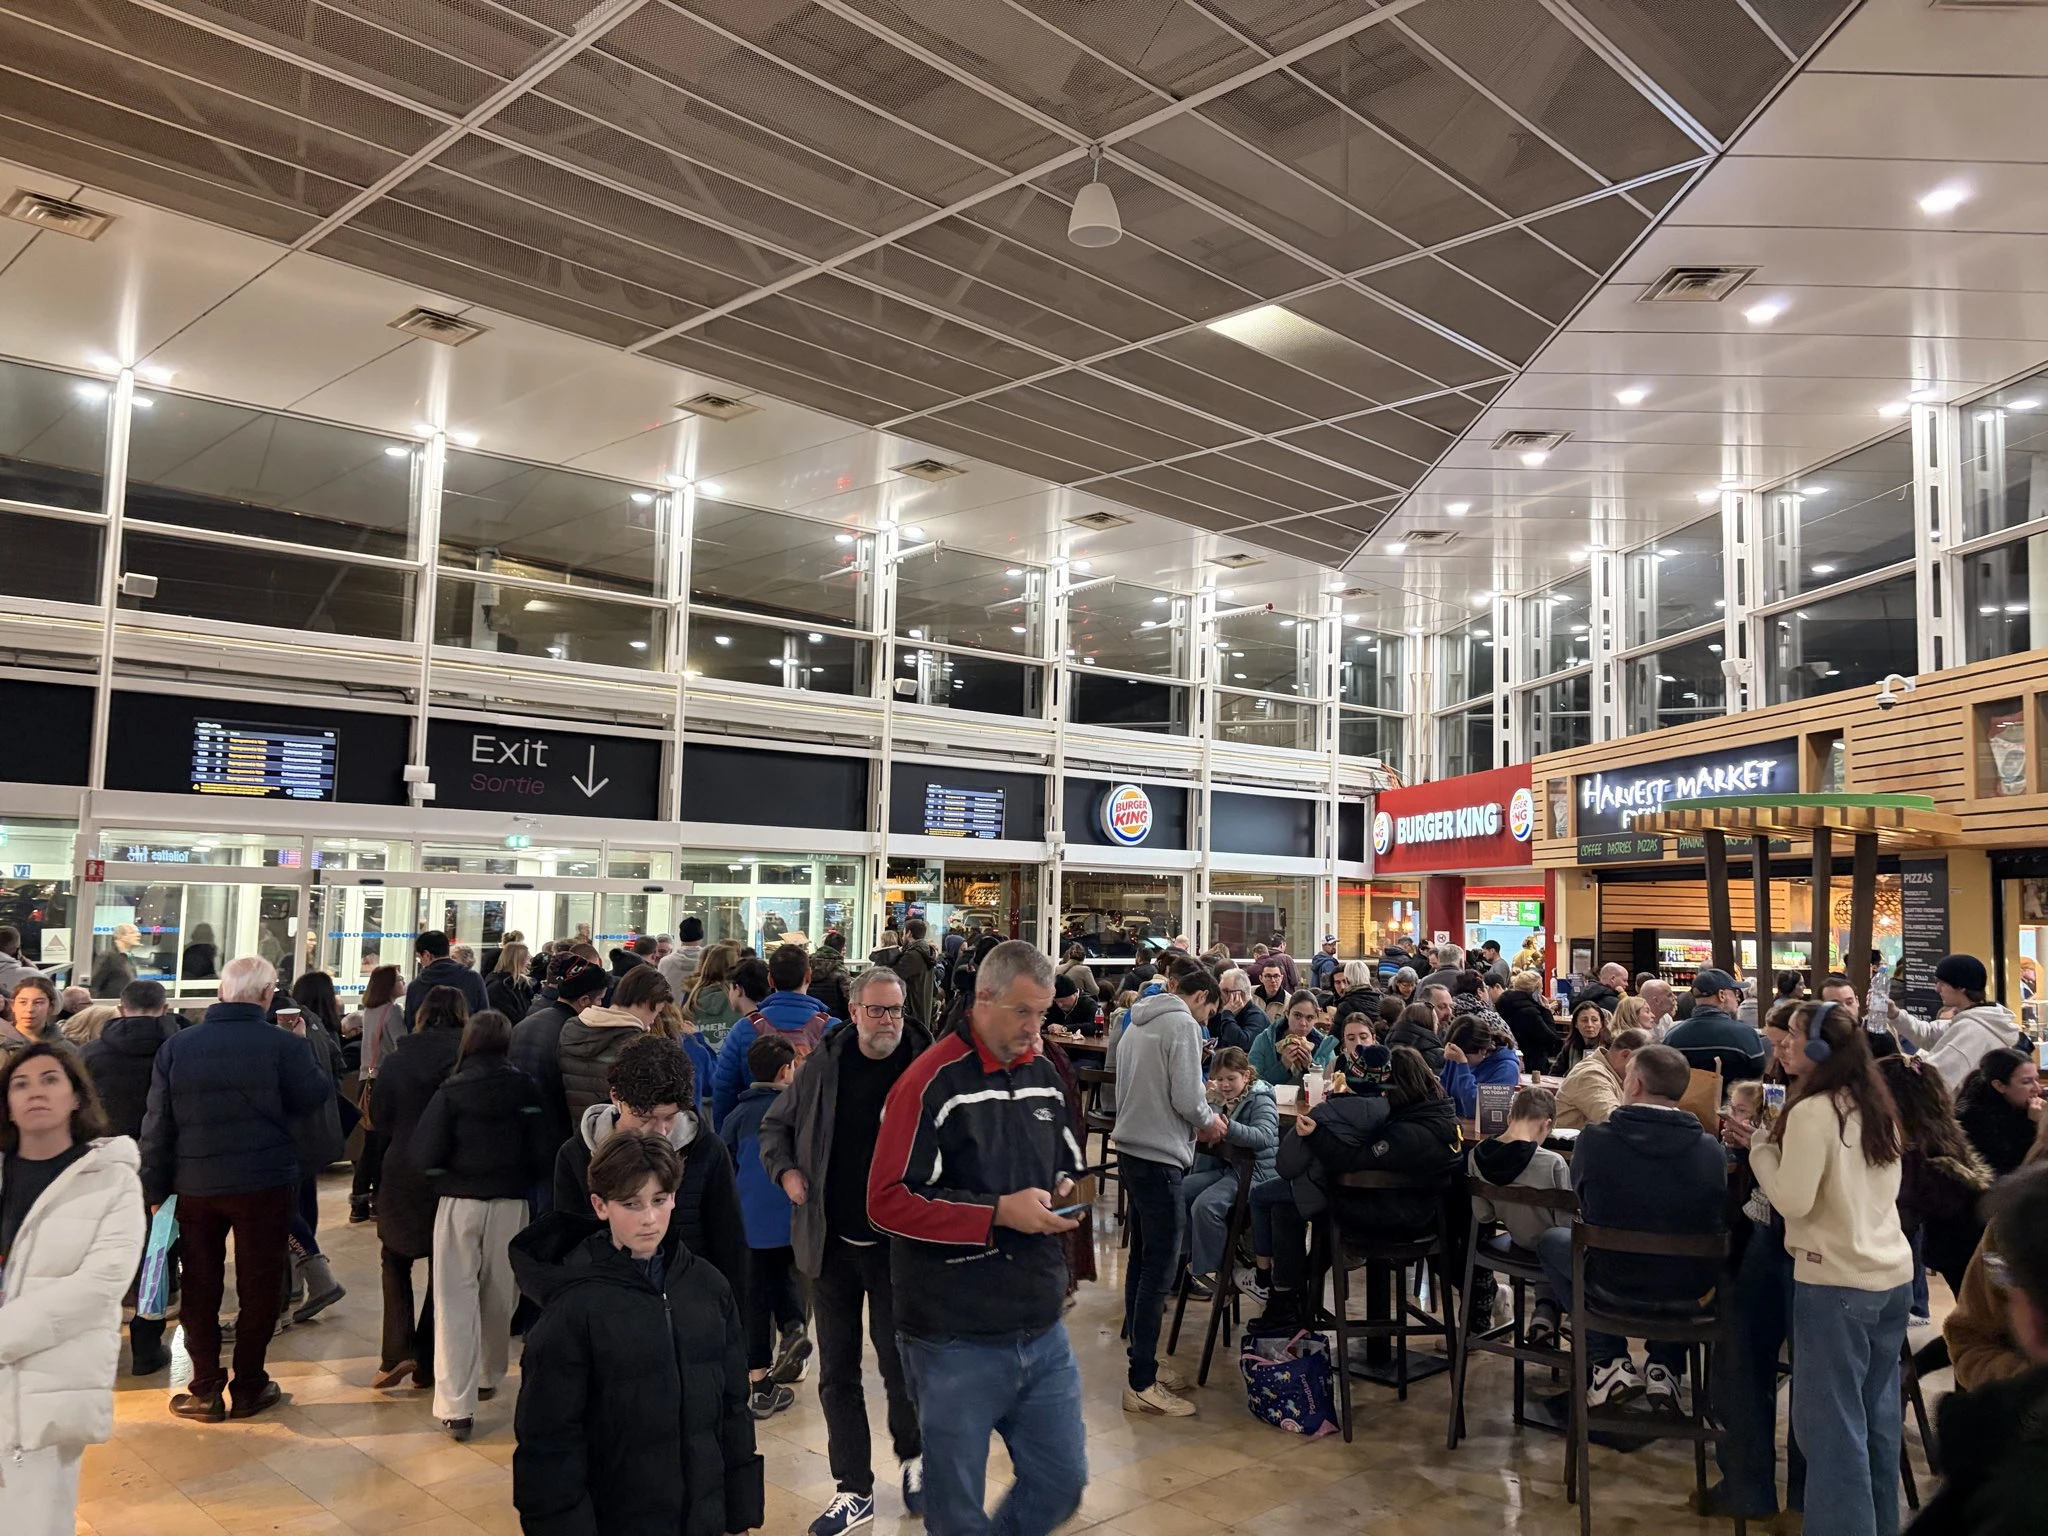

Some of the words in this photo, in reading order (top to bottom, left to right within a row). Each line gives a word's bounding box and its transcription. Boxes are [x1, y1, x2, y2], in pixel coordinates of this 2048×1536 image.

[471, 734, 549, 768] Exit
[470, 773, 545, 795] Sortie
[1583, 773, 1671, 815] HARVEST
[1676, 760, 1778, 799] MARKET
[1115, 800, 1147, 813] BURGER
[1114, 810, 1148, 827] KING
[1397, 810, 1454, 844] BURGER
[1456, 802, 1498, 838] KING
[1580, 843, 1602, 857] COFFEE
[1607, 841, 1632, 855] PASTRIES
[1637, 838, 1659, 853] PIZZAS
[1903, 872, 1933, 884] PIZZAS
